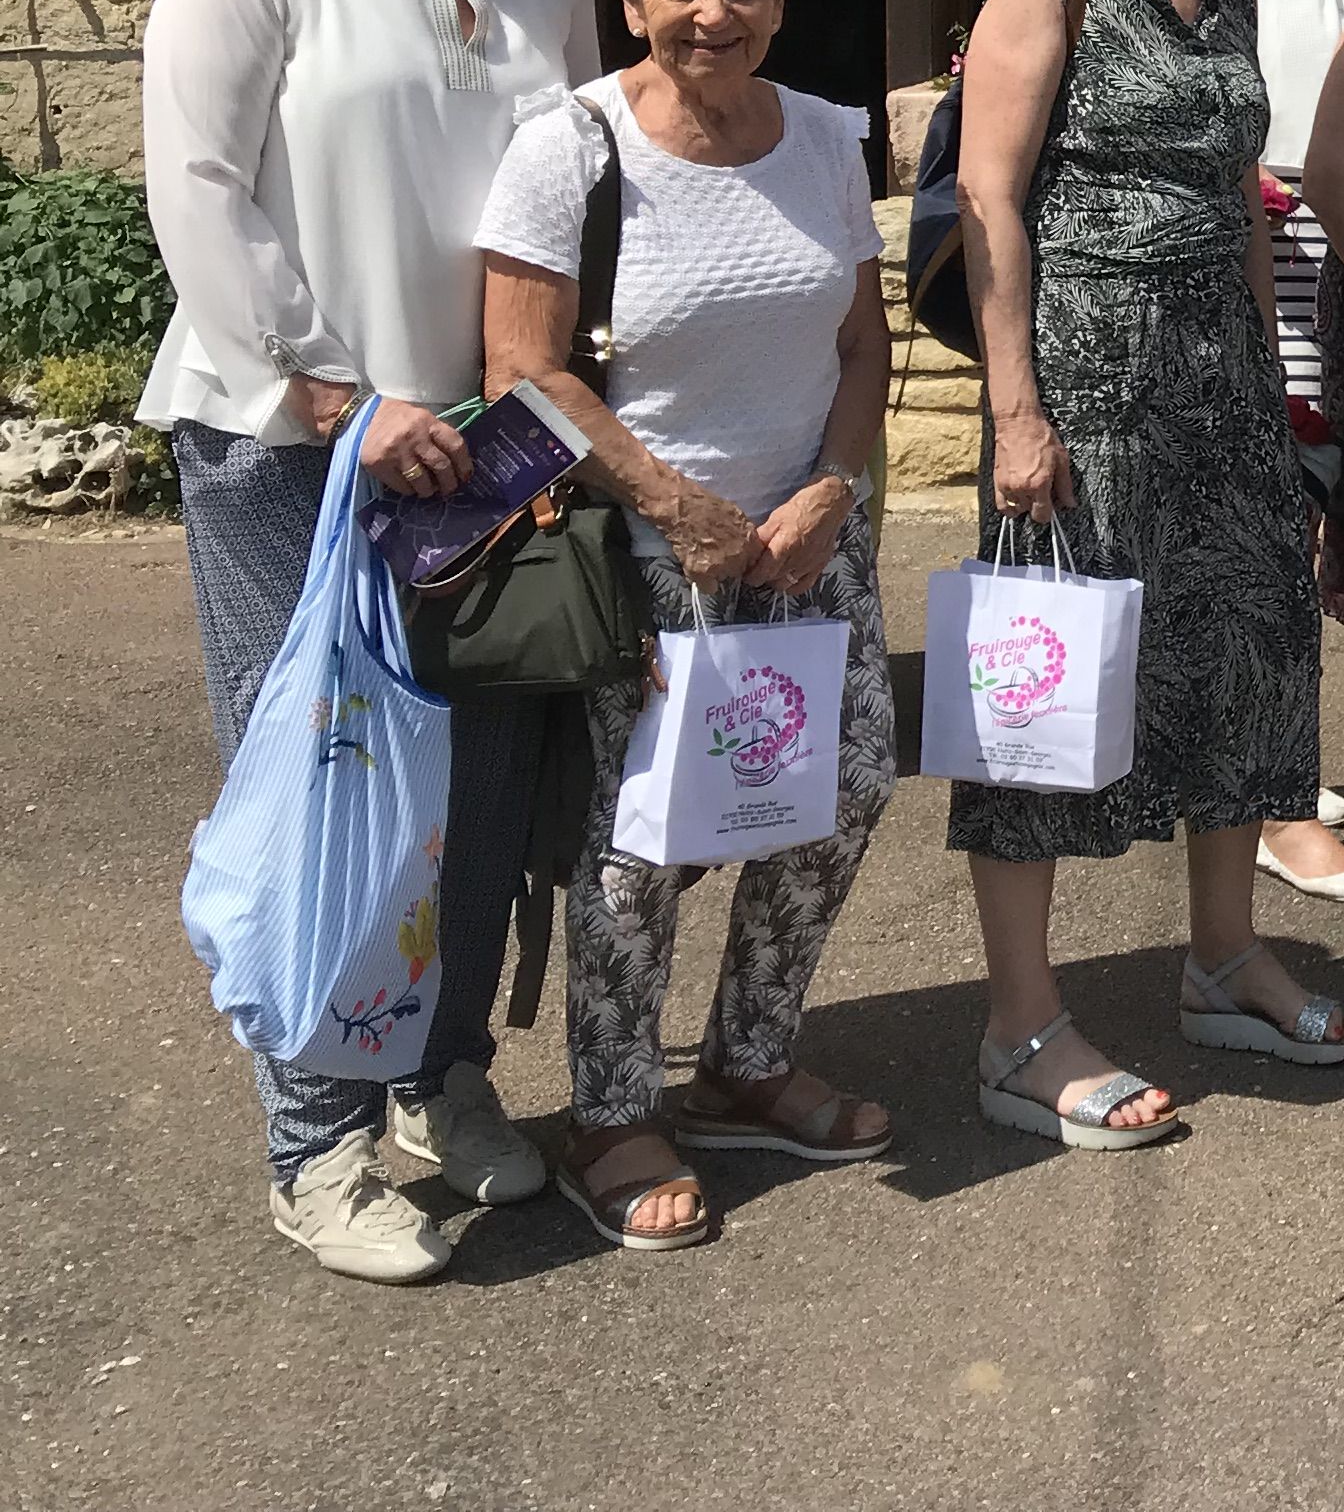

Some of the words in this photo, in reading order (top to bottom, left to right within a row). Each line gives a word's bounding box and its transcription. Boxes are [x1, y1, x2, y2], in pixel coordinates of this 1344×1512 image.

[969, 633, 1041, 659] Fruirouge
[985, 654, 996, 671] &
[1001, 650, 1026, 668] Cie
[706, 681, 776, 725] Fruirouge
[724, 715, 736, 733] &
[740, 705, 763, 725] Cie
